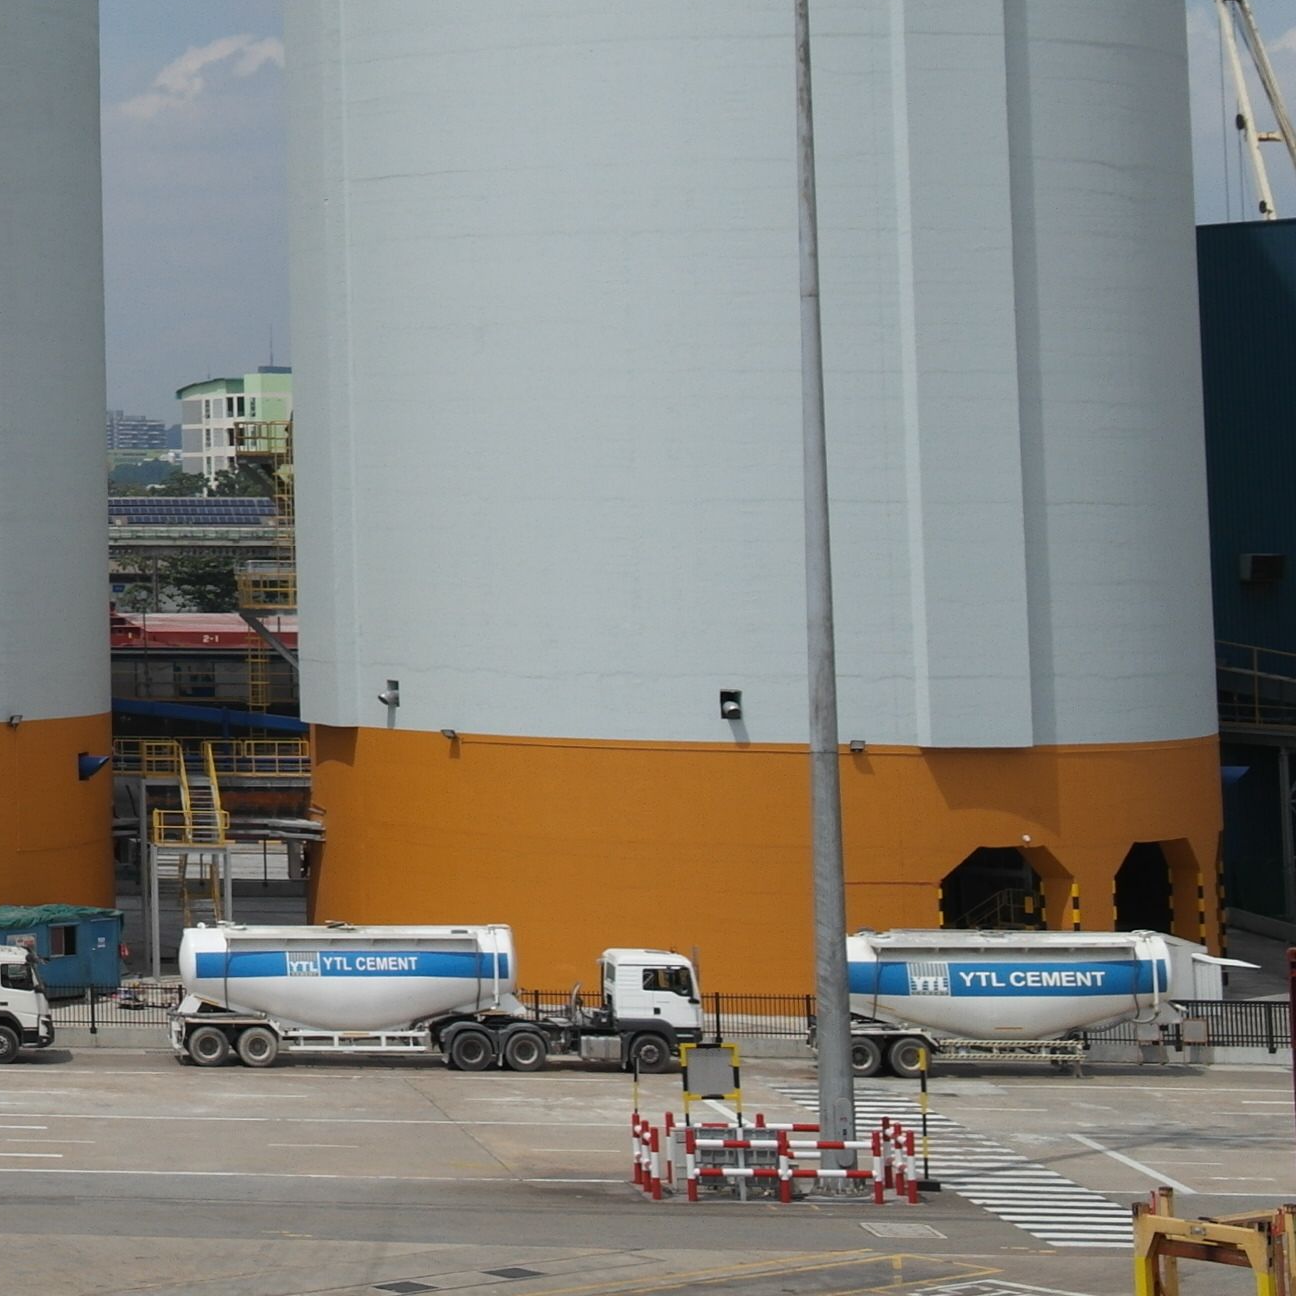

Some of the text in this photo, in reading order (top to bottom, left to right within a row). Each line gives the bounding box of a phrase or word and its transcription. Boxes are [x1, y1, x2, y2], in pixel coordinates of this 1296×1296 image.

[290, 961, 318, 972] YTL
[322, 956, 418, 971] YTL CEMENT
[911, 976, 948, 991] YTL
[959, 971, 1105, 987] YTL CEMENT
